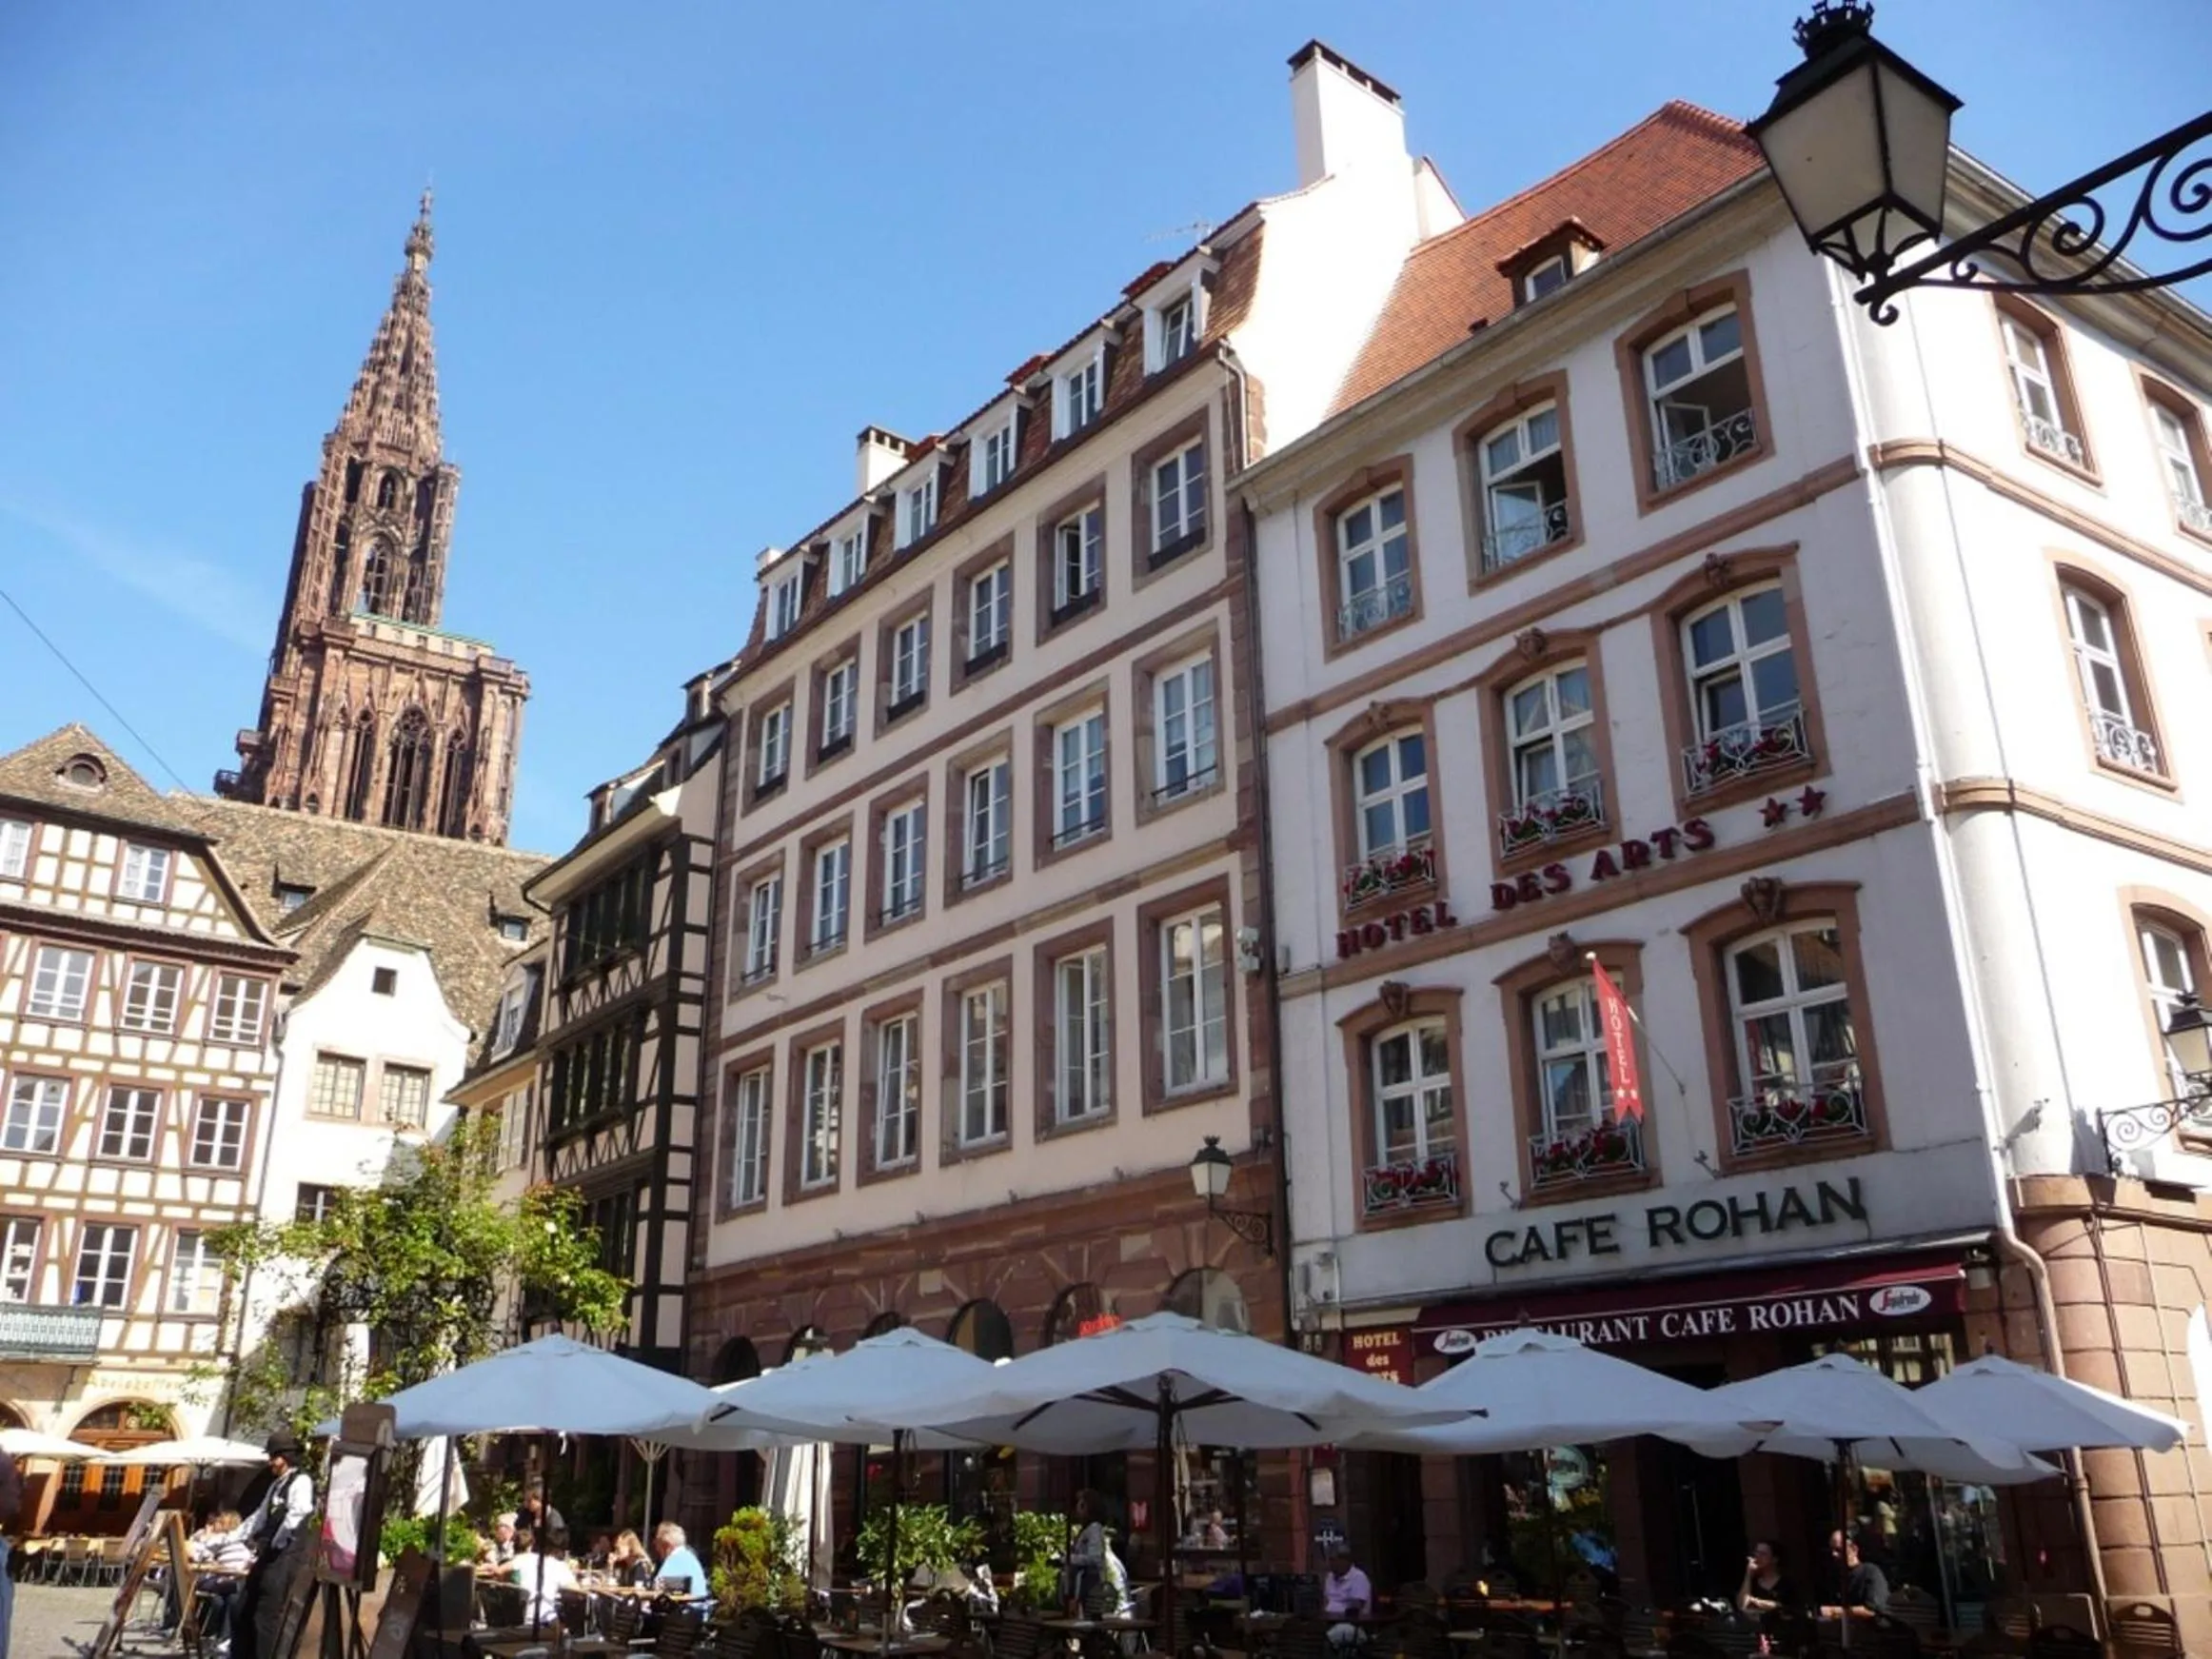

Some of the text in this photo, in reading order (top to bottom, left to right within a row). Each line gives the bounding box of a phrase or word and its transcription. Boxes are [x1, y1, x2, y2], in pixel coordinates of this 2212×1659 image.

[1335, 819, 1714, 958] HOTEL DES ARTS
[1608, 997, 1630, 1084] HOTEL
[1485, 1176, 1866, 1268] CAFE ROHAN
[1353, 1332, 1401, 1349] HOTEL
[1660, 1308, 1736, 1338] CAFE
[1749, 1294, 1862, 1331] ROHAN
[1366, 1353, 1390, 1368] des
